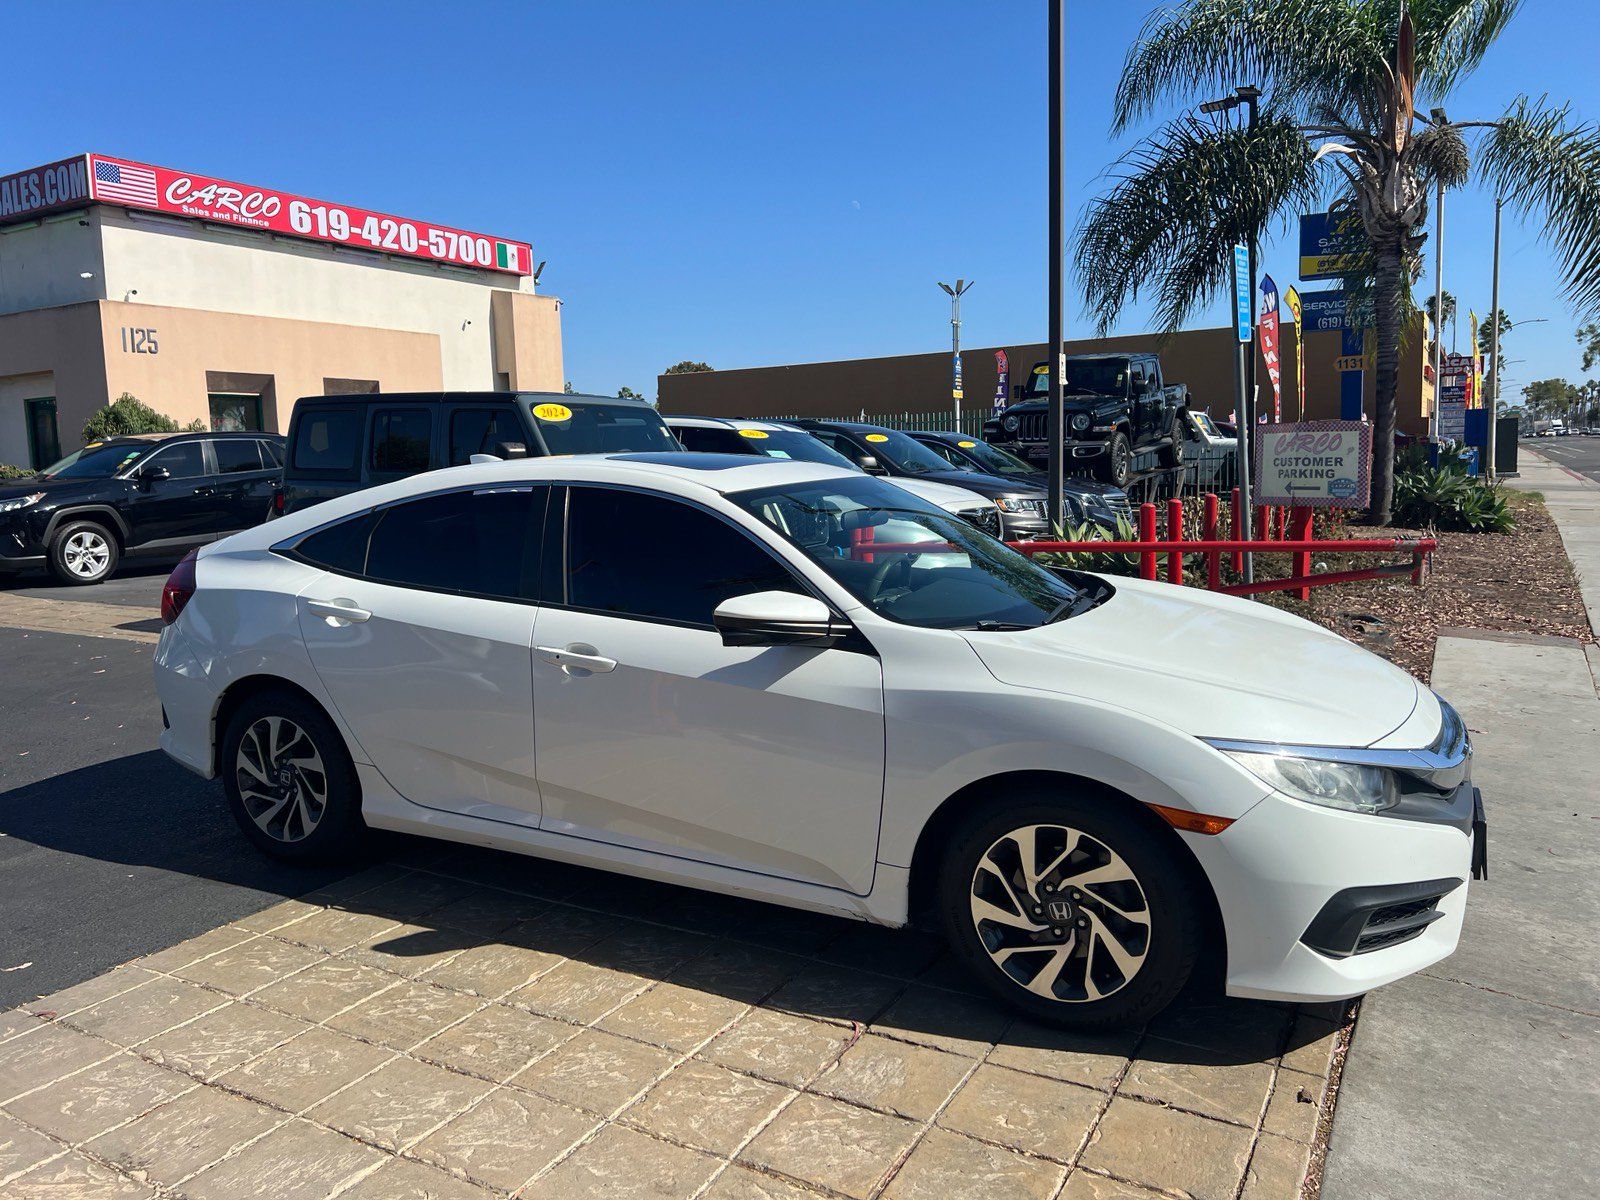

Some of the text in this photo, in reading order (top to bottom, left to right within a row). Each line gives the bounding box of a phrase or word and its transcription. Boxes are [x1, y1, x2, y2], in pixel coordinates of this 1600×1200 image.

[0, 160, 87, 217] ALES.COM
[164, 177, 281, 218] CARCO
[182, 205, 270, 227] Sales and Finance
[288, 200, 492, 266] 619-420-5700
[1317, 316, 1342, 329] (619)
[121, 326, 159, 354] 1125
[1336, 358, 1364, 371] 1131
[540, 407, 565, 418] 2024
[1274, 433, 1343, 456] CARCO
[1273, 456, 1344, 468] CUSTOMER
[1277, 469, 1336, 479] PARKING
